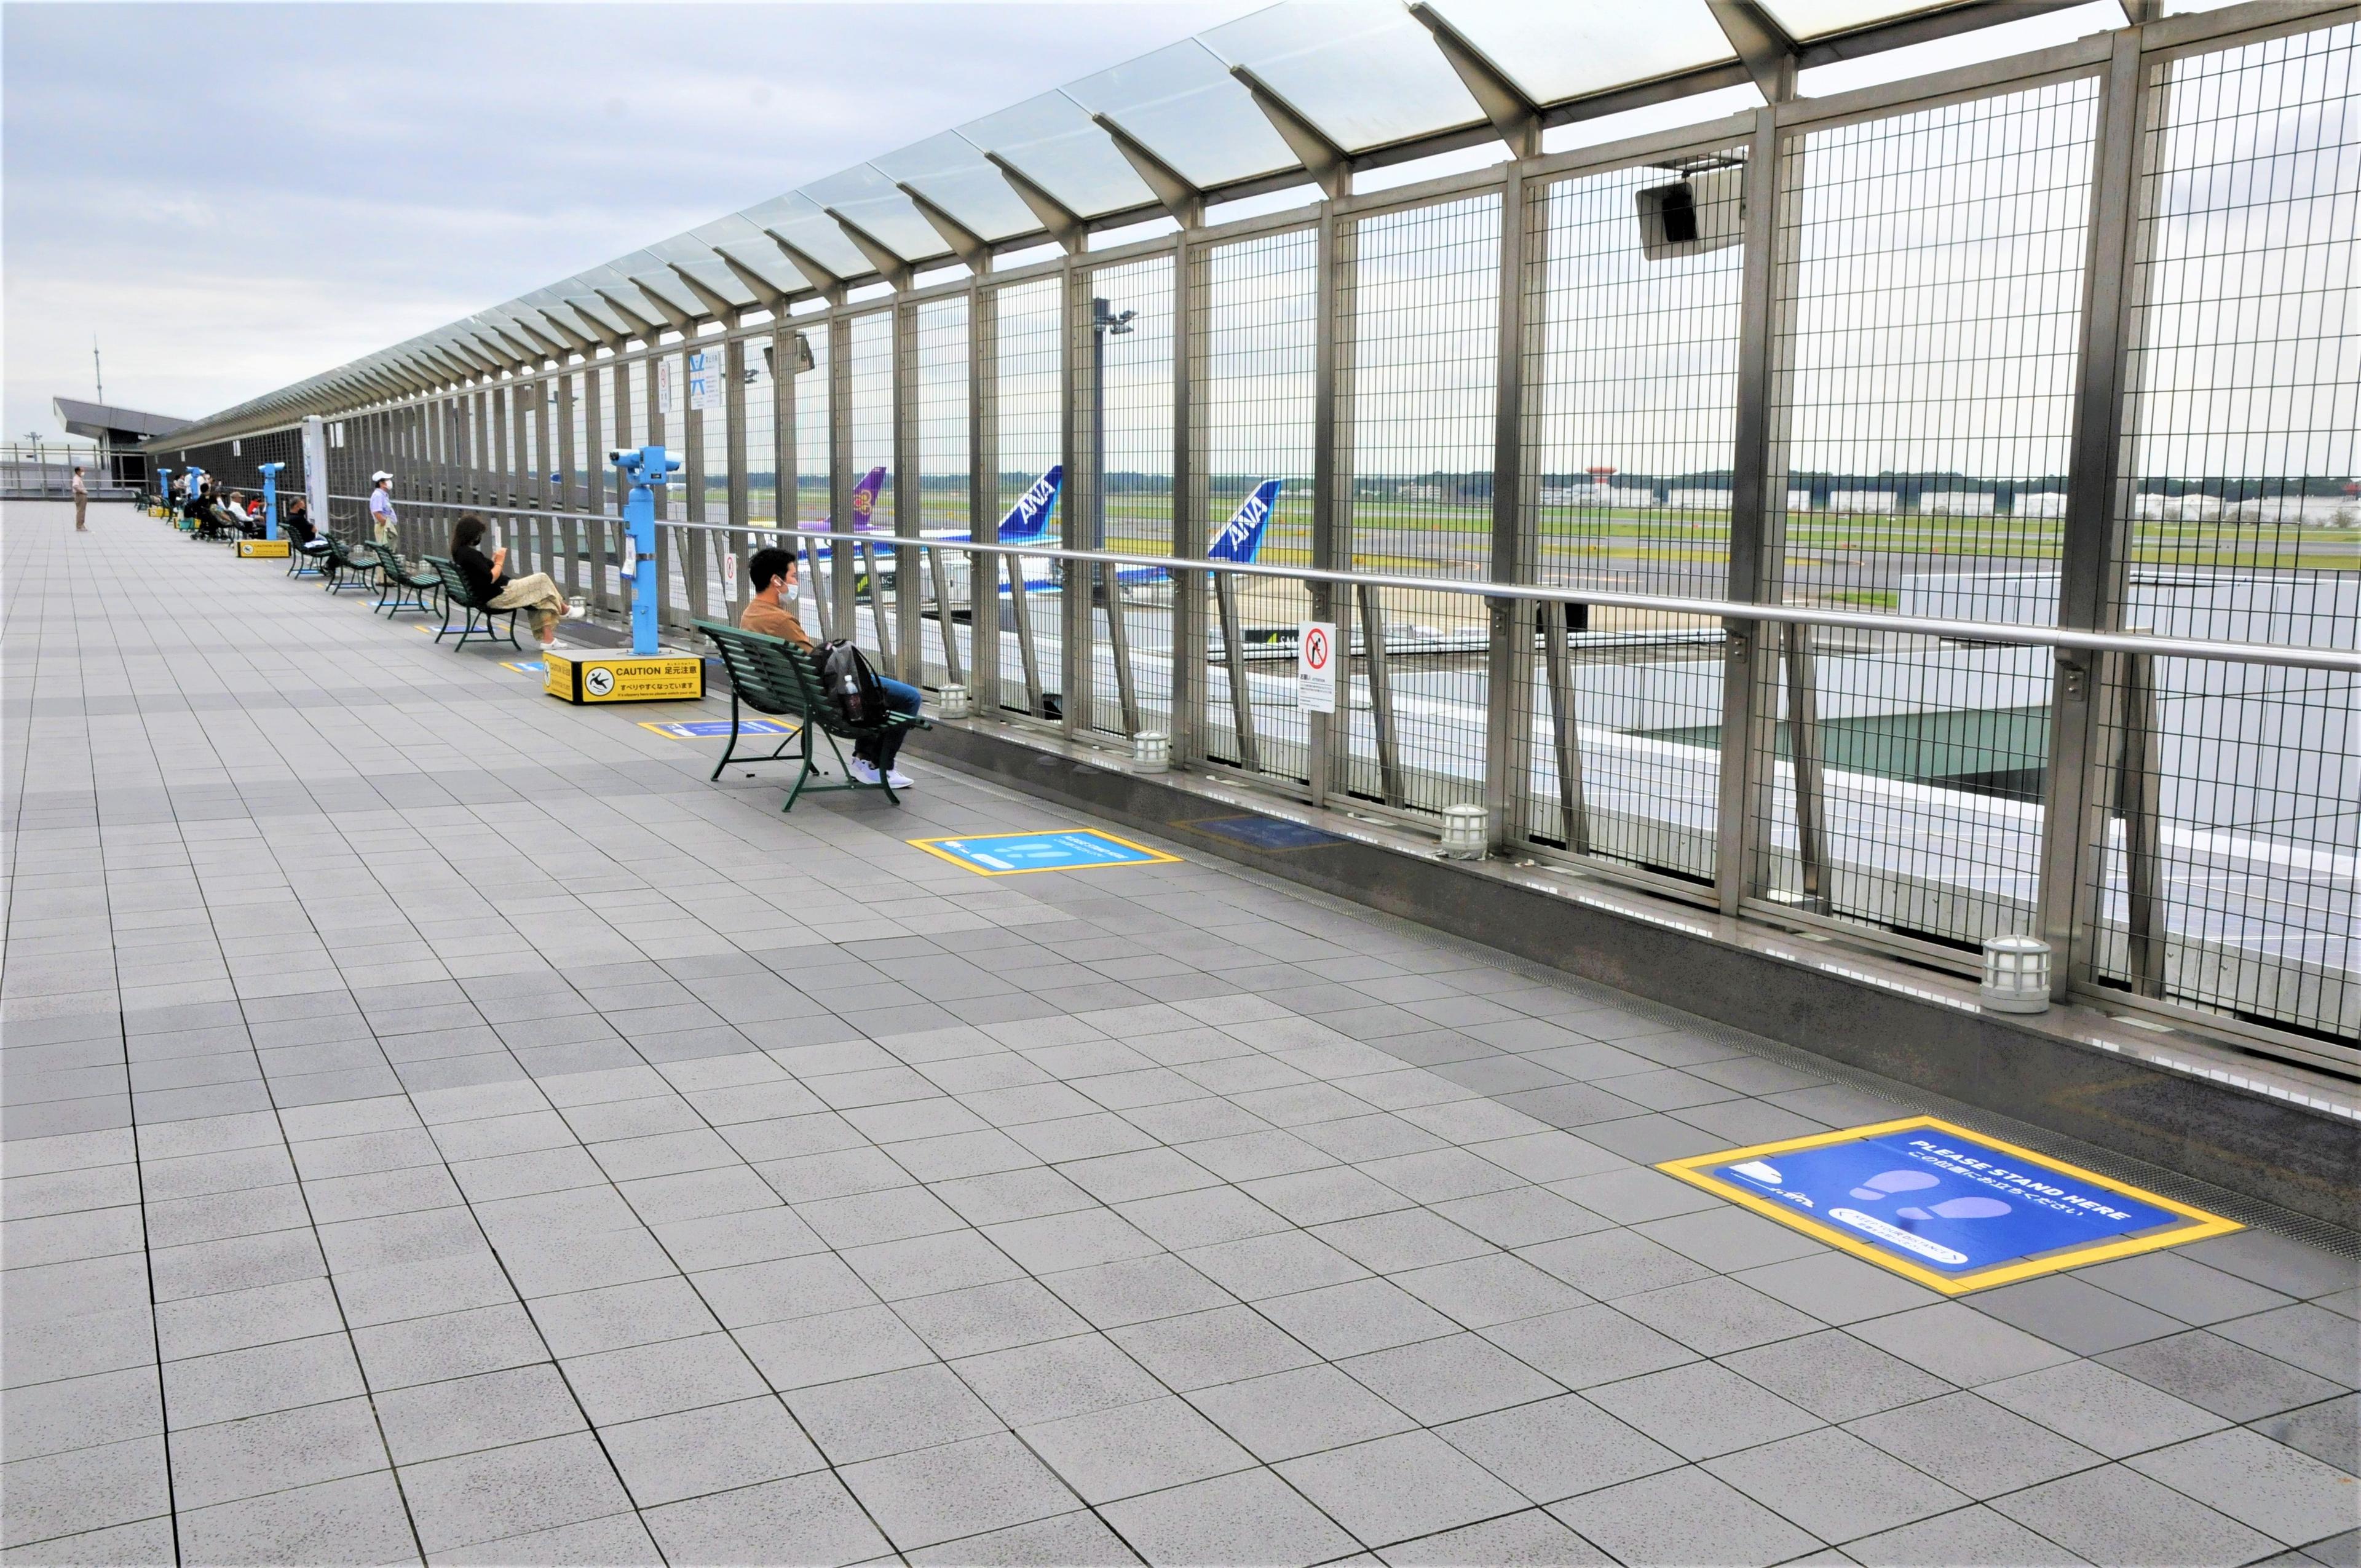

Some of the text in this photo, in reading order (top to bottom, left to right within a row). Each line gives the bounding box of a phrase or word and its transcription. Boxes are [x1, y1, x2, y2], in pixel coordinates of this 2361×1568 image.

[1020, 479, 1056, 525] ANA
[1228, 496, 1267, 552] ANA
[616, 666, 697, 676] CAUTION 足元注意
[1908, 1140, 2132, 1221] PLEASE STAND HERE
[1908, 1151, 2084, 1216] この位置にお立ちください
[1853, 1215, 1950, 1254] KEEP YOUR DISTANCE
